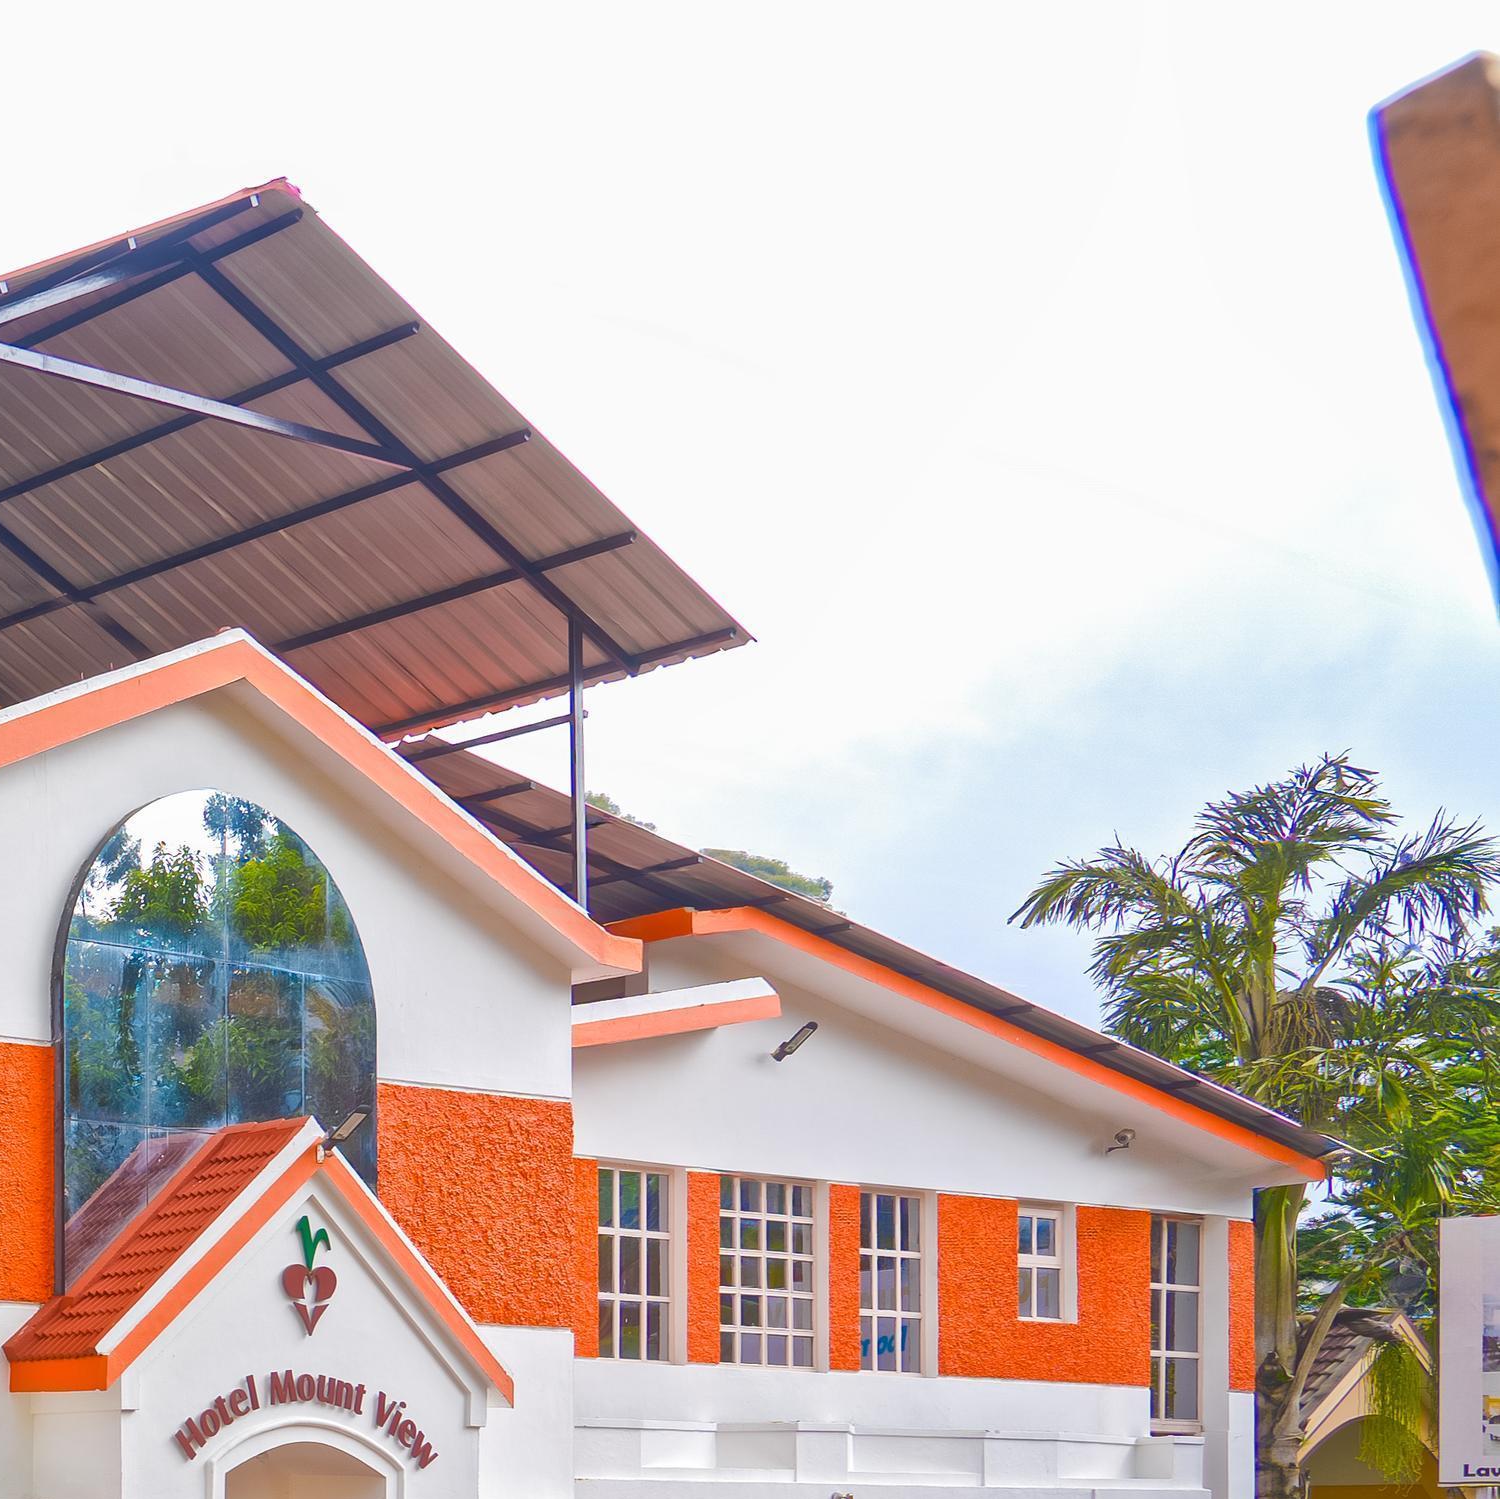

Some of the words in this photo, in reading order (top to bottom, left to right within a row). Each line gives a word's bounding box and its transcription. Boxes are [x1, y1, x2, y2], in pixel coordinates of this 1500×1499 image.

[174, 1374, 260, 1461] Hotel
[270, 1369, 366, 1415] Mount
[376, 1390, 439, 1470] View
